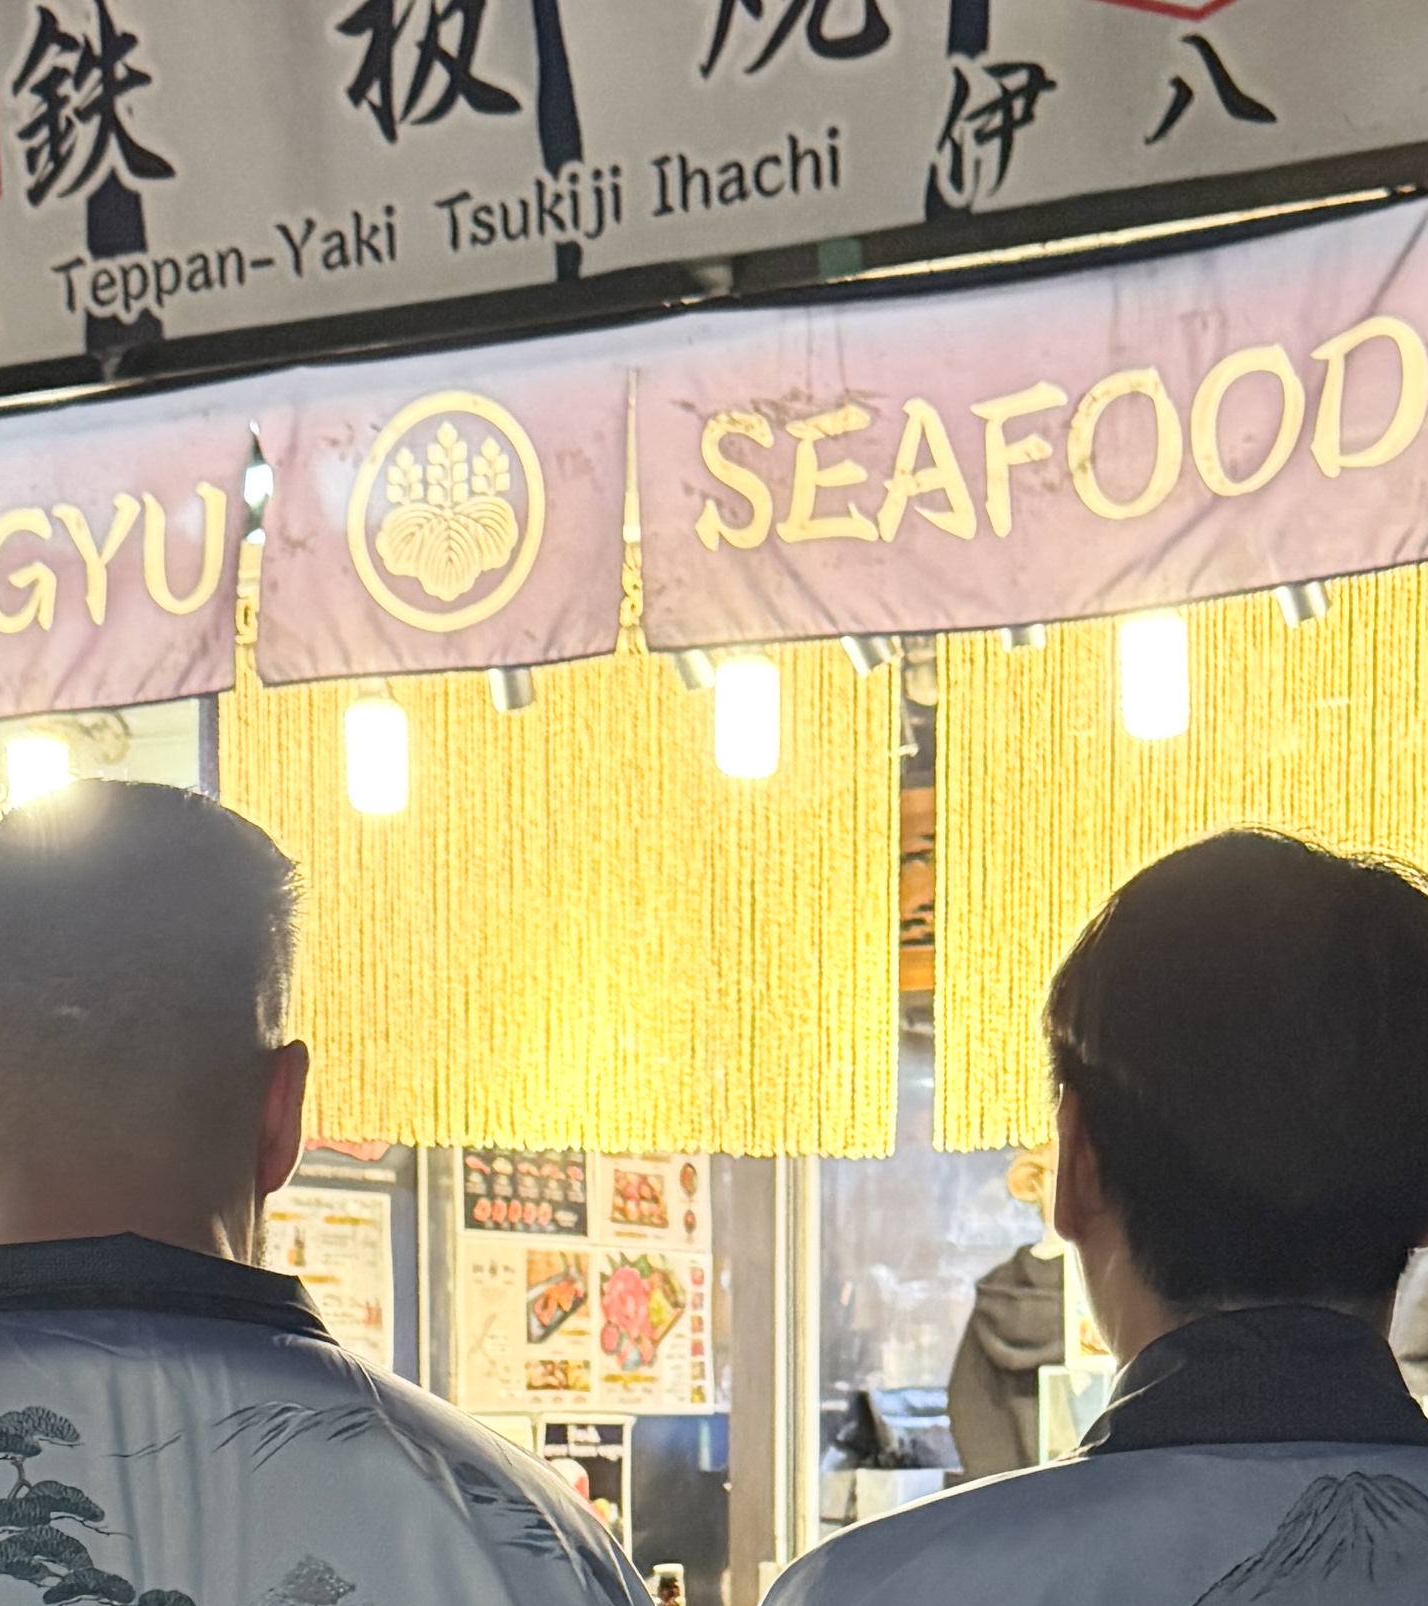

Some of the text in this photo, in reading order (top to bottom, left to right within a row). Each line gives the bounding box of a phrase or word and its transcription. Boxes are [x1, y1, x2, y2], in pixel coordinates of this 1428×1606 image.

[935, 33, 1277, 197] 伊八
[51, 126, 842, 316] Teppan-Yaki Tsukiji Ihachi
